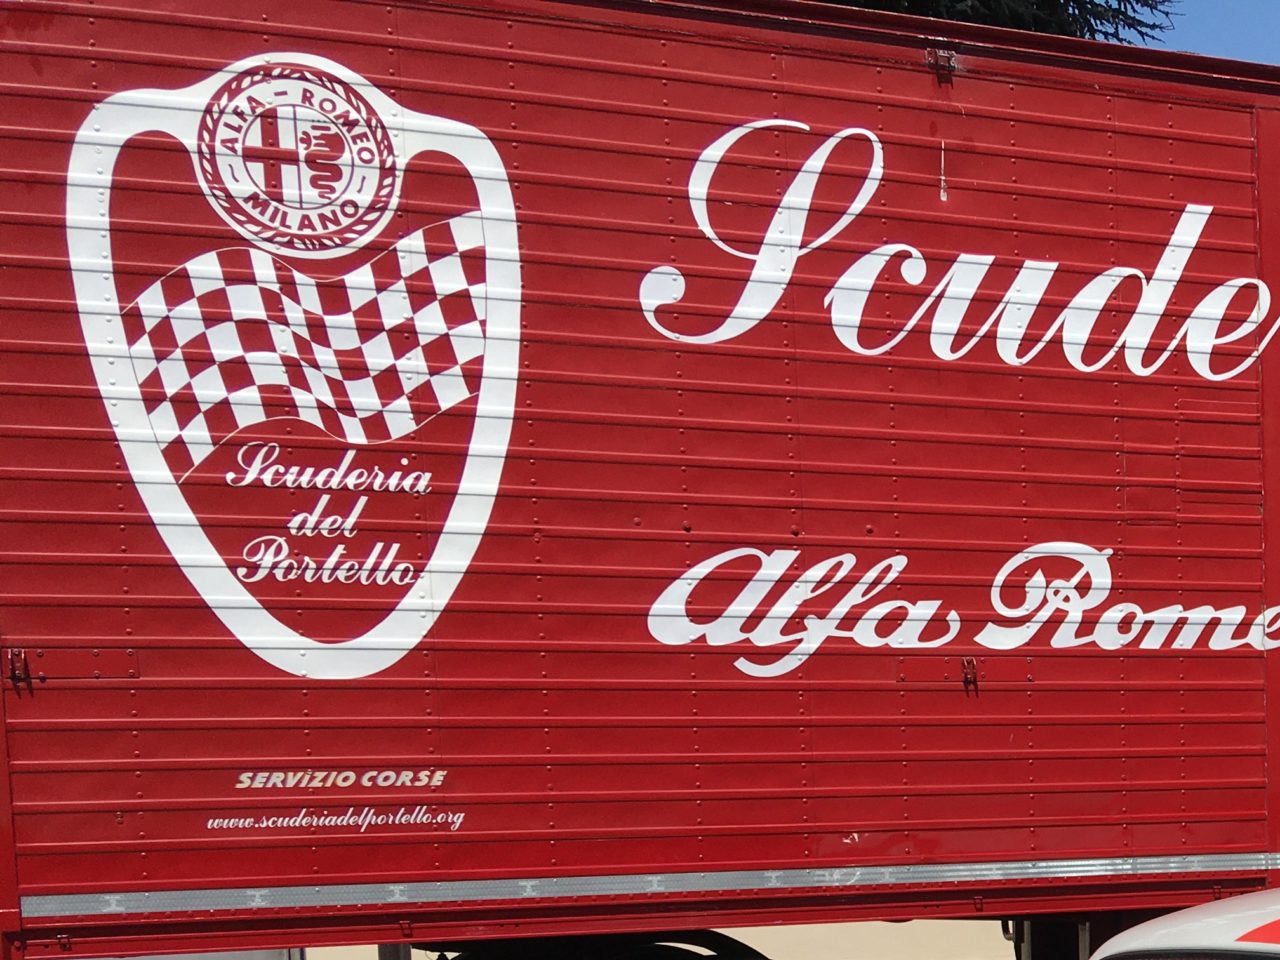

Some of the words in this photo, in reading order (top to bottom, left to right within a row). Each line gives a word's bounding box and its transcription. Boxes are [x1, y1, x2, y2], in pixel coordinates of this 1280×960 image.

[219, 95, 266, 155] ALFA
[301, 88, 376, 165] ROMEO
[243, 191, 360, 232] MILANO
[225, 441, 432, 495] Scuderia
[286, 494, 369, 538] del
[236, 535, 422, 586] Portello
[647, 547, 961, 678] Alfa
[235, 770, 356, 789] SERVIZIO
[360, 770, 448, 787] CORSE
[206, 805, 466, 833] www.scuderiadelportello.org
